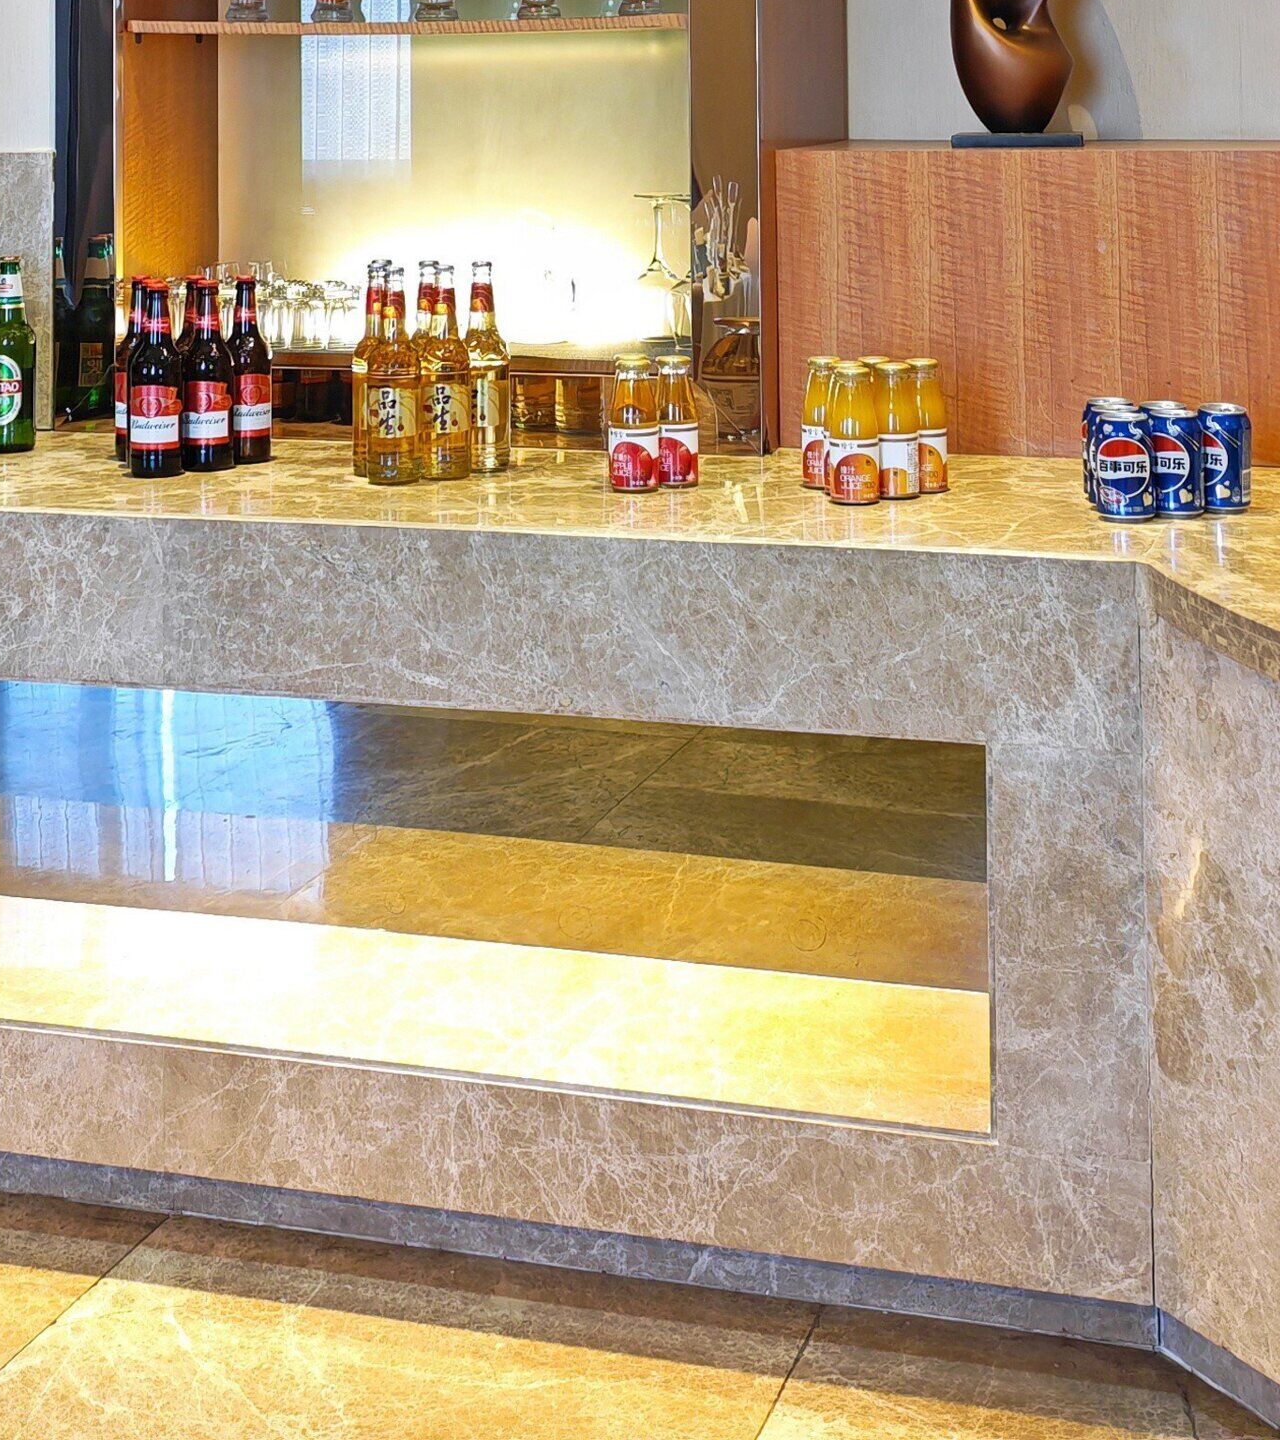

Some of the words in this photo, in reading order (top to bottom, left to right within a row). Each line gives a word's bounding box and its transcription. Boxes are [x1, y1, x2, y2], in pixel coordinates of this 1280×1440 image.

[130, 419, 176, 430] Budweiser
[1098, 459, 1148, 474] 百事可乐
[840, 474, 871, 482] ORANGE
[840, 481, 863, 490] JUICE
